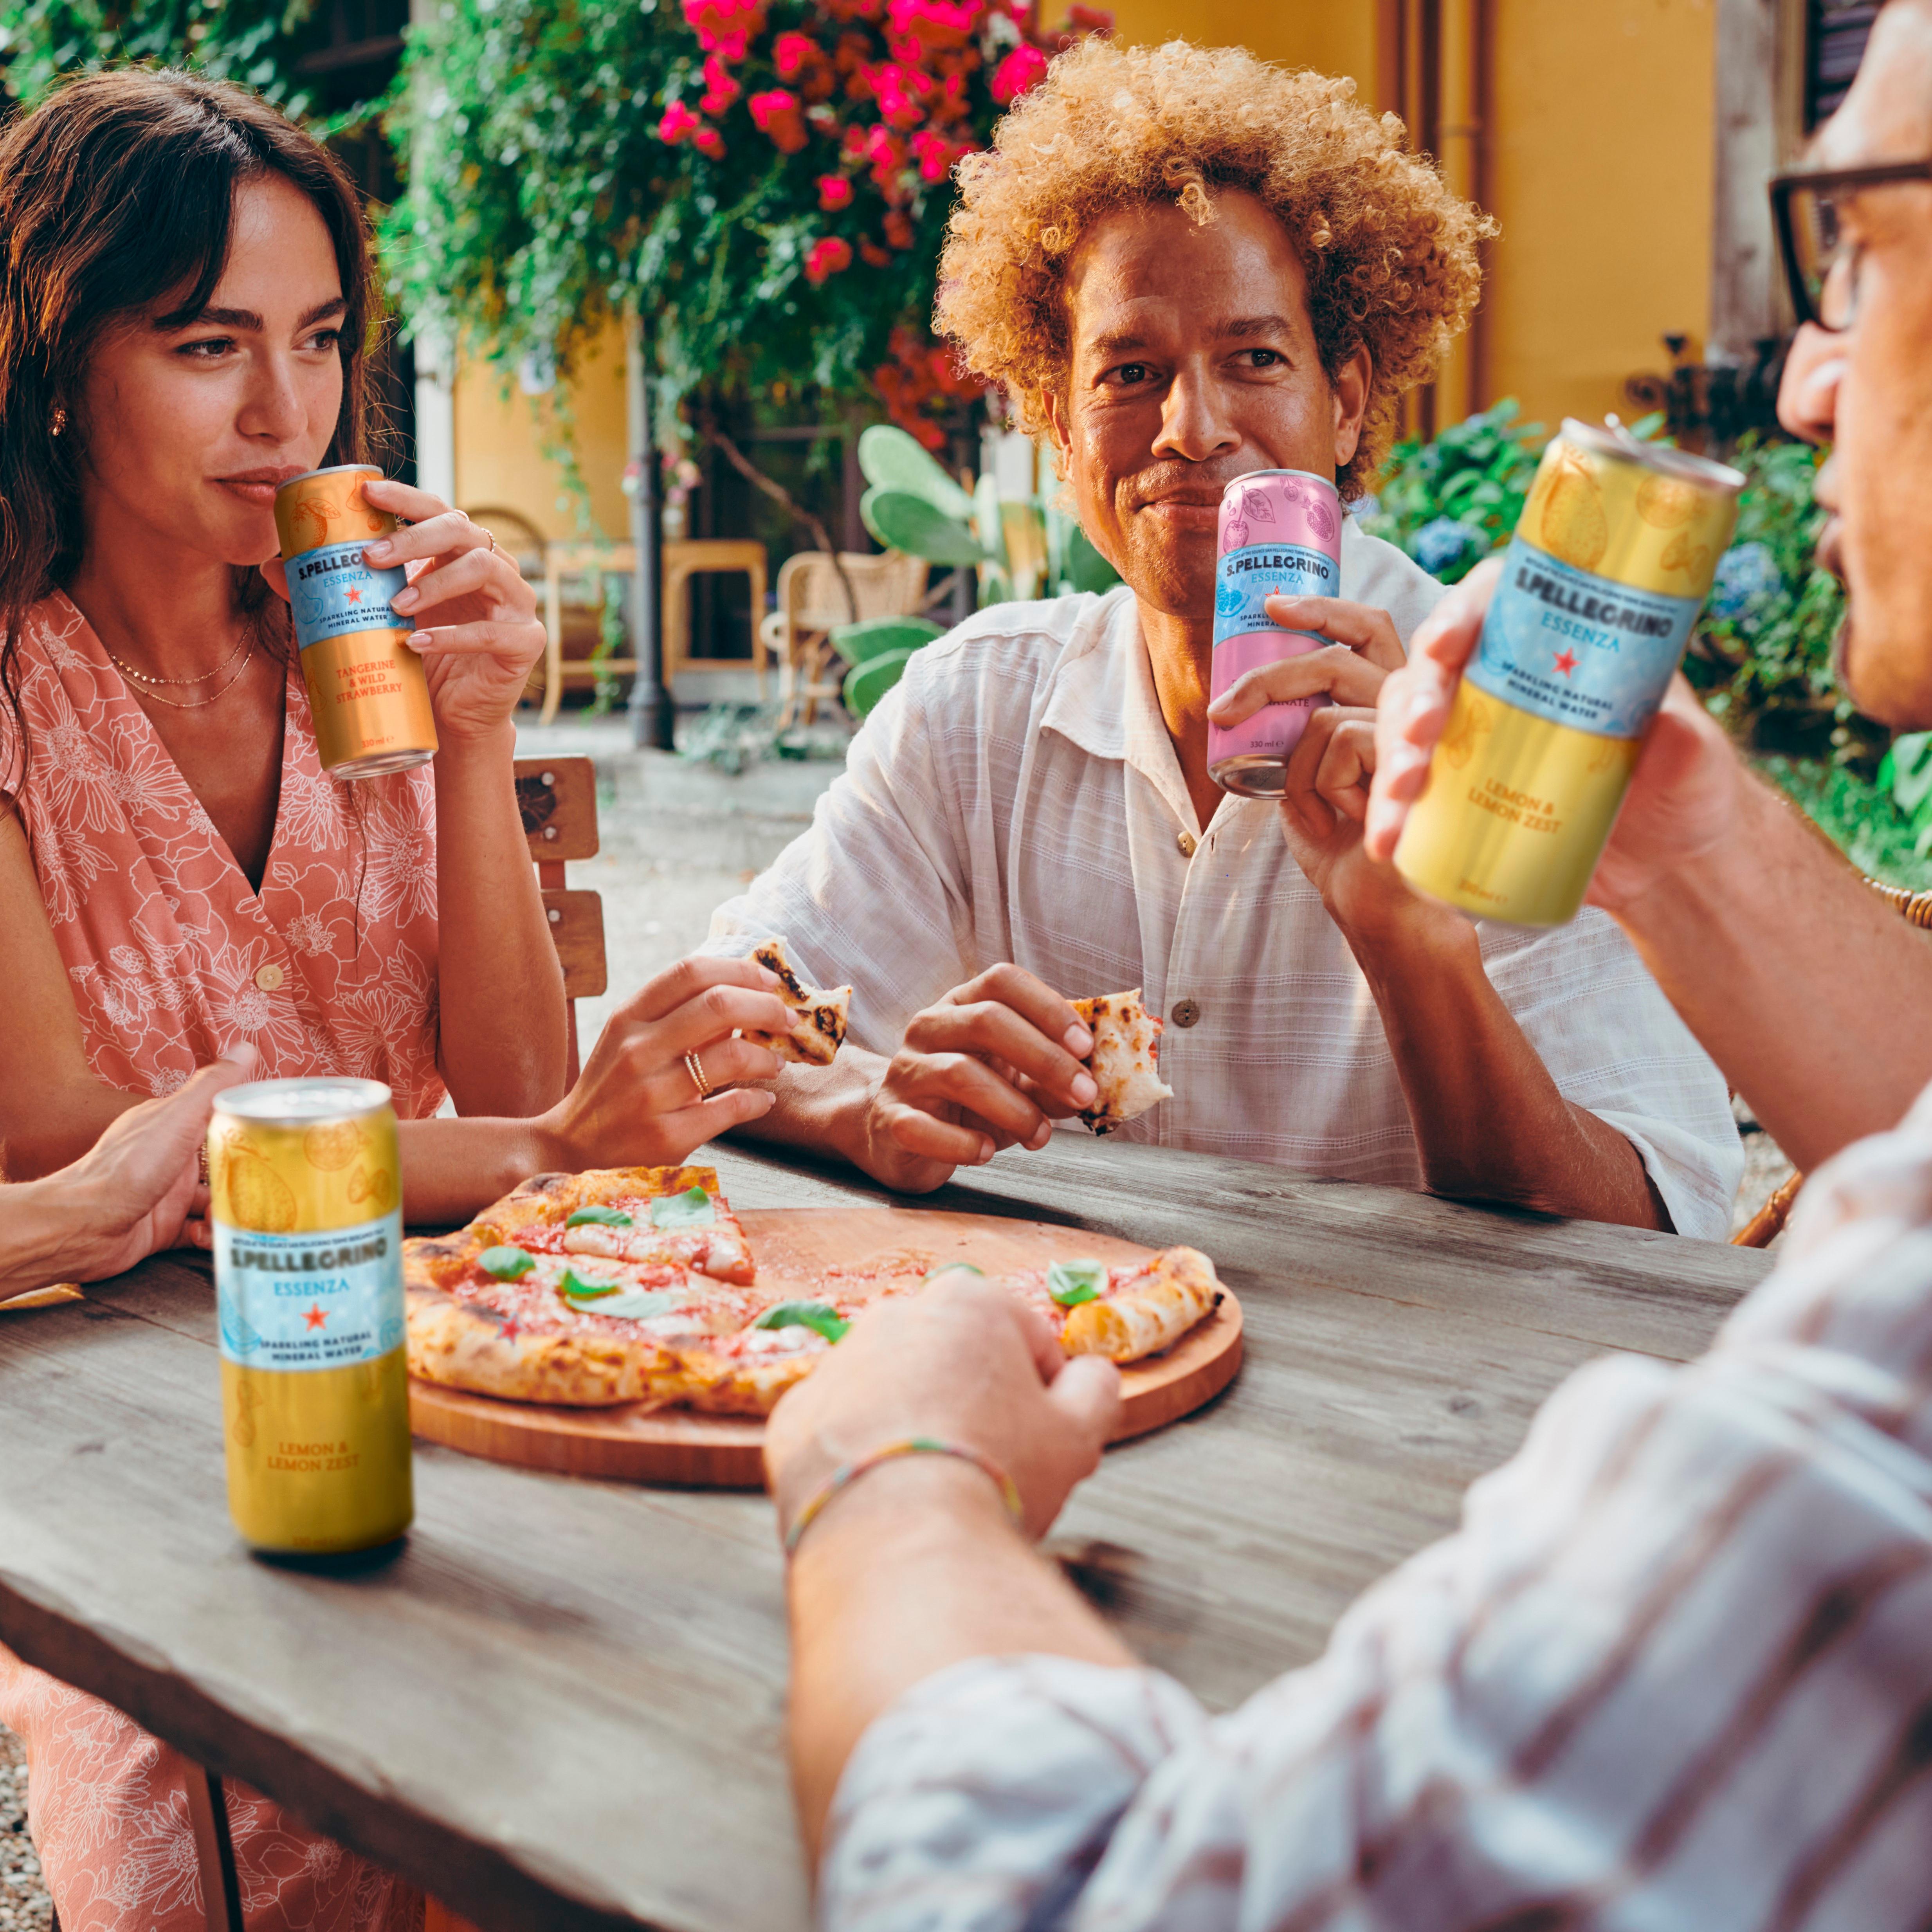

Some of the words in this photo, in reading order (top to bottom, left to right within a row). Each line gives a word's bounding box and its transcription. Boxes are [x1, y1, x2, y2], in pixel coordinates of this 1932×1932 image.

[299, 553, 362, 580] S.PELLEG
[1227, 555, 1329, 579] S.PELLEGRINO
[323, 571, 373, 587] ESSENZA
[1252, 571, 1303, 584] ESSENZA
[319, 609, 358, 624] SPARKLING
[328, 618, 360, 629] MINERAL
[1541, 611, 1620, 653] ESSENZA
[336, 660, 396, 679] TANGERINE
[349, 678, 356, 688] &
[358, 673, 386, 685] WILD
[336, 683, 402, 704] STRAWBERRY
[1485, 778, 1541, 811] LEMON
[1468, 787, 1522, 823] LEMON
[1524, 815, 1563, 834] ZEST
[275, 1278, 350, 1296] ESSENZA
[261, 1340, 319, 1348] SPARKLING
[323, 1331, 371, 1346] NATURAL
[325, 1345, 361, 1358] WATER
[279, 1441, 334, 1456] LEMON
[268, 1455, 321, 1472] LEMON
[326, 1454, 360, 1472] ZEST
